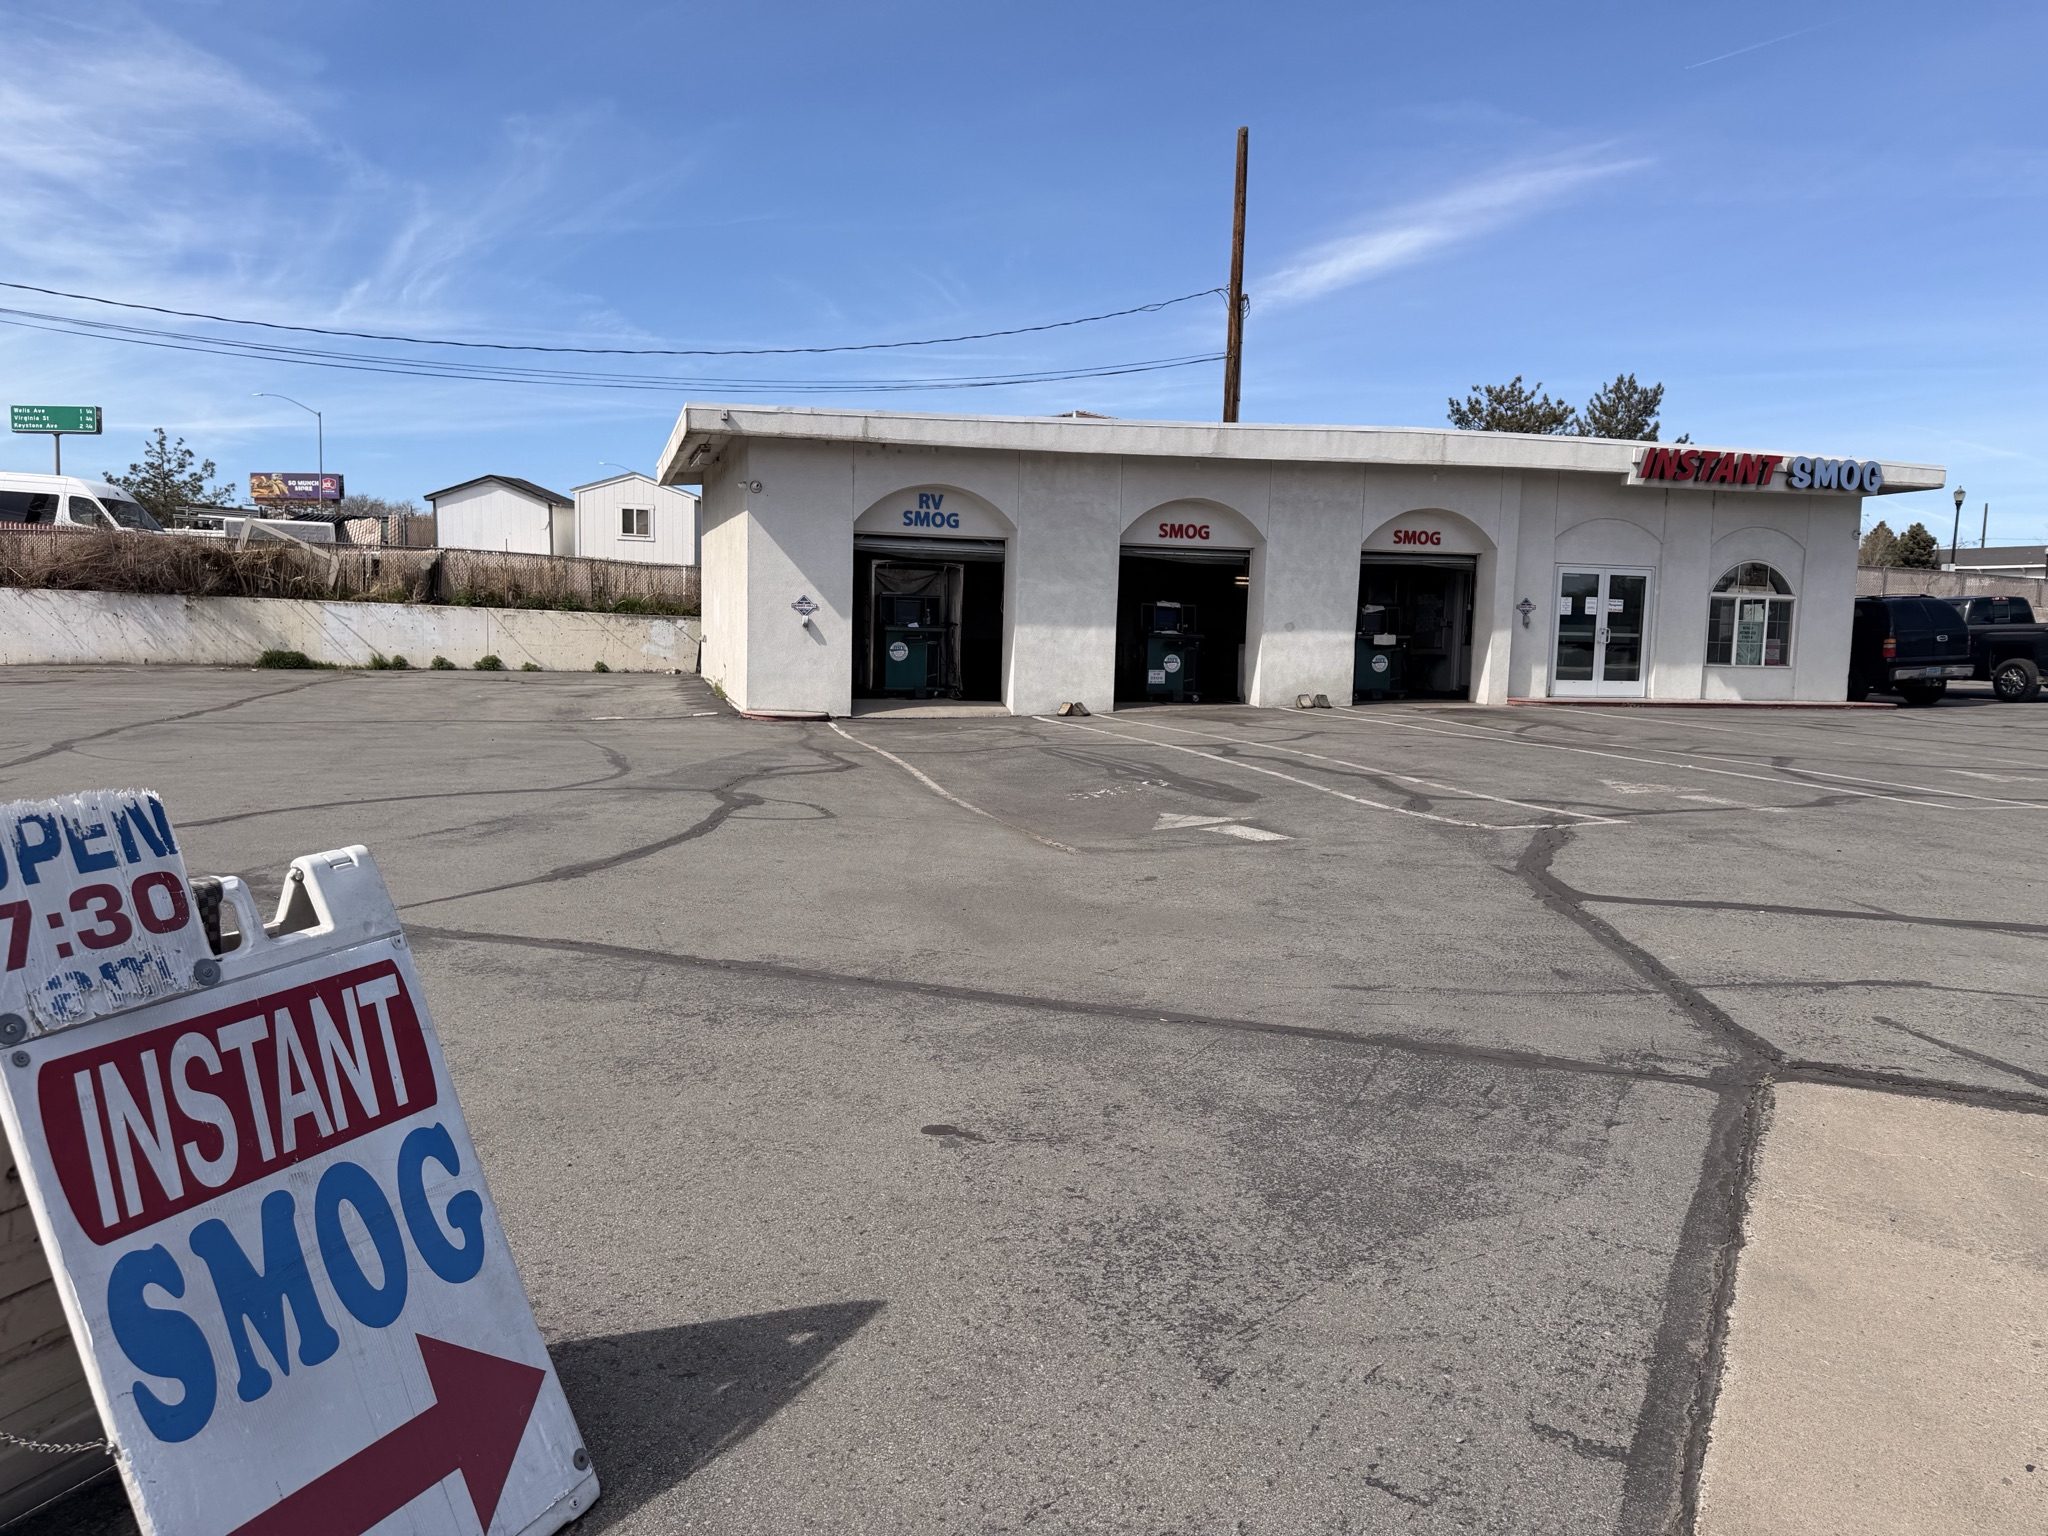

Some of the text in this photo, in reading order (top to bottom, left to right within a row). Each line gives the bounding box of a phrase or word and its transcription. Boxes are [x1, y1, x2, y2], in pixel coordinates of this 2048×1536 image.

[1638, 447, 1883, 493] INSTANT SMOG
[918, 493, 944, 510] RV
[903, 510, 960, 529] SMOG
[1158, 522, 1210, 540] SMOG
[1393, 529, 1442, 546] SMOG
[0, 871, 191, 972] 7:30
[73, 972, 409, 1229] INSTANT
[106, 1122, 486, 1443] SMOG
